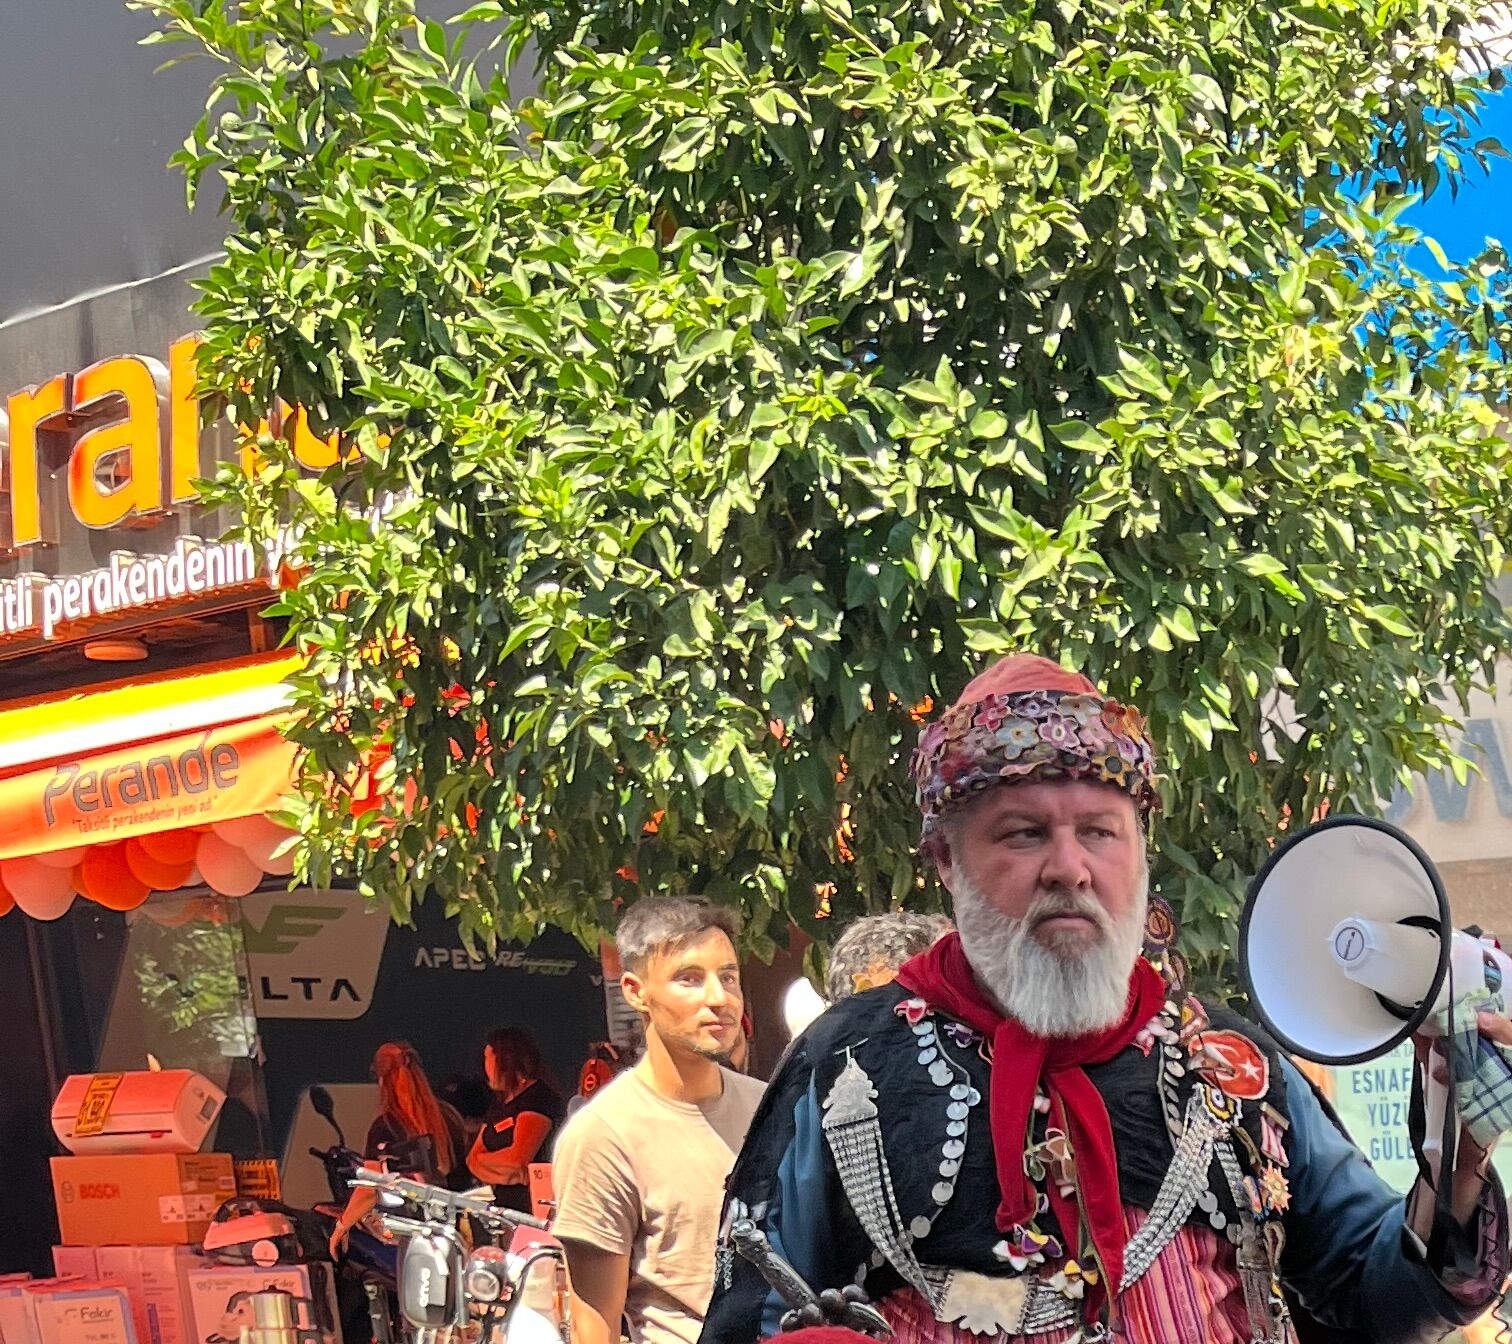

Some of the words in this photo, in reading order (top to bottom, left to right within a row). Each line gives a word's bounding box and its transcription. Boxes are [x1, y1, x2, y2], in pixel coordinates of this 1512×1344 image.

[43, 729, 239, 826] Perande
[1351, 1067, 1411, 1094] ESNAF
[79, 1183, 121, 1200] BOSCH
[80, 1306, 113, 1320] Fakir
